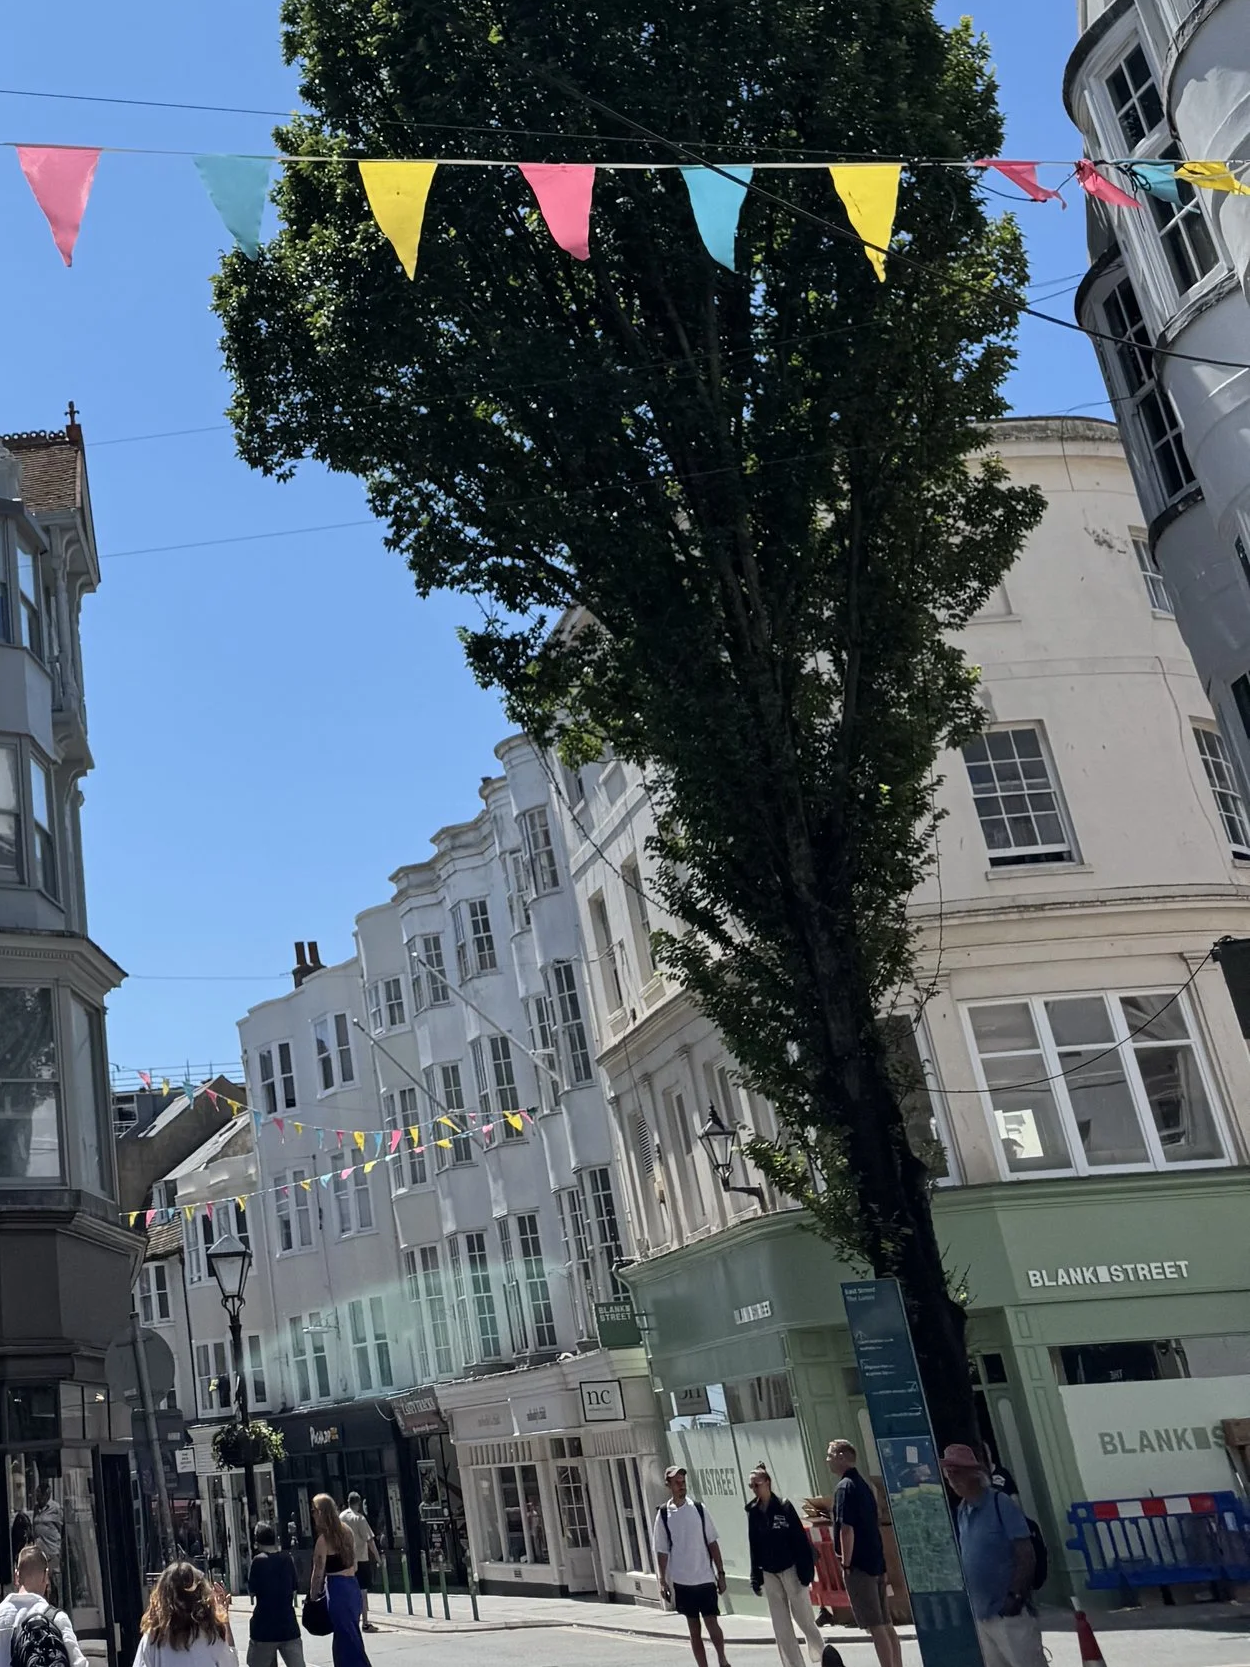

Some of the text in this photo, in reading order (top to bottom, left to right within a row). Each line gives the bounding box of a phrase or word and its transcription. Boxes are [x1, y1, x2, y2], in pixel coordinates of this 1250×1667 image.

[1027, 1260, 1189, 1288] BLANK STREET
[599, 1313, 631, 1322] STREET
[586, 1389, 612, 1405] nc
[1098, 1428, 1193, 1455] BLANK
[705, 1467, 738, 1496] STREET
